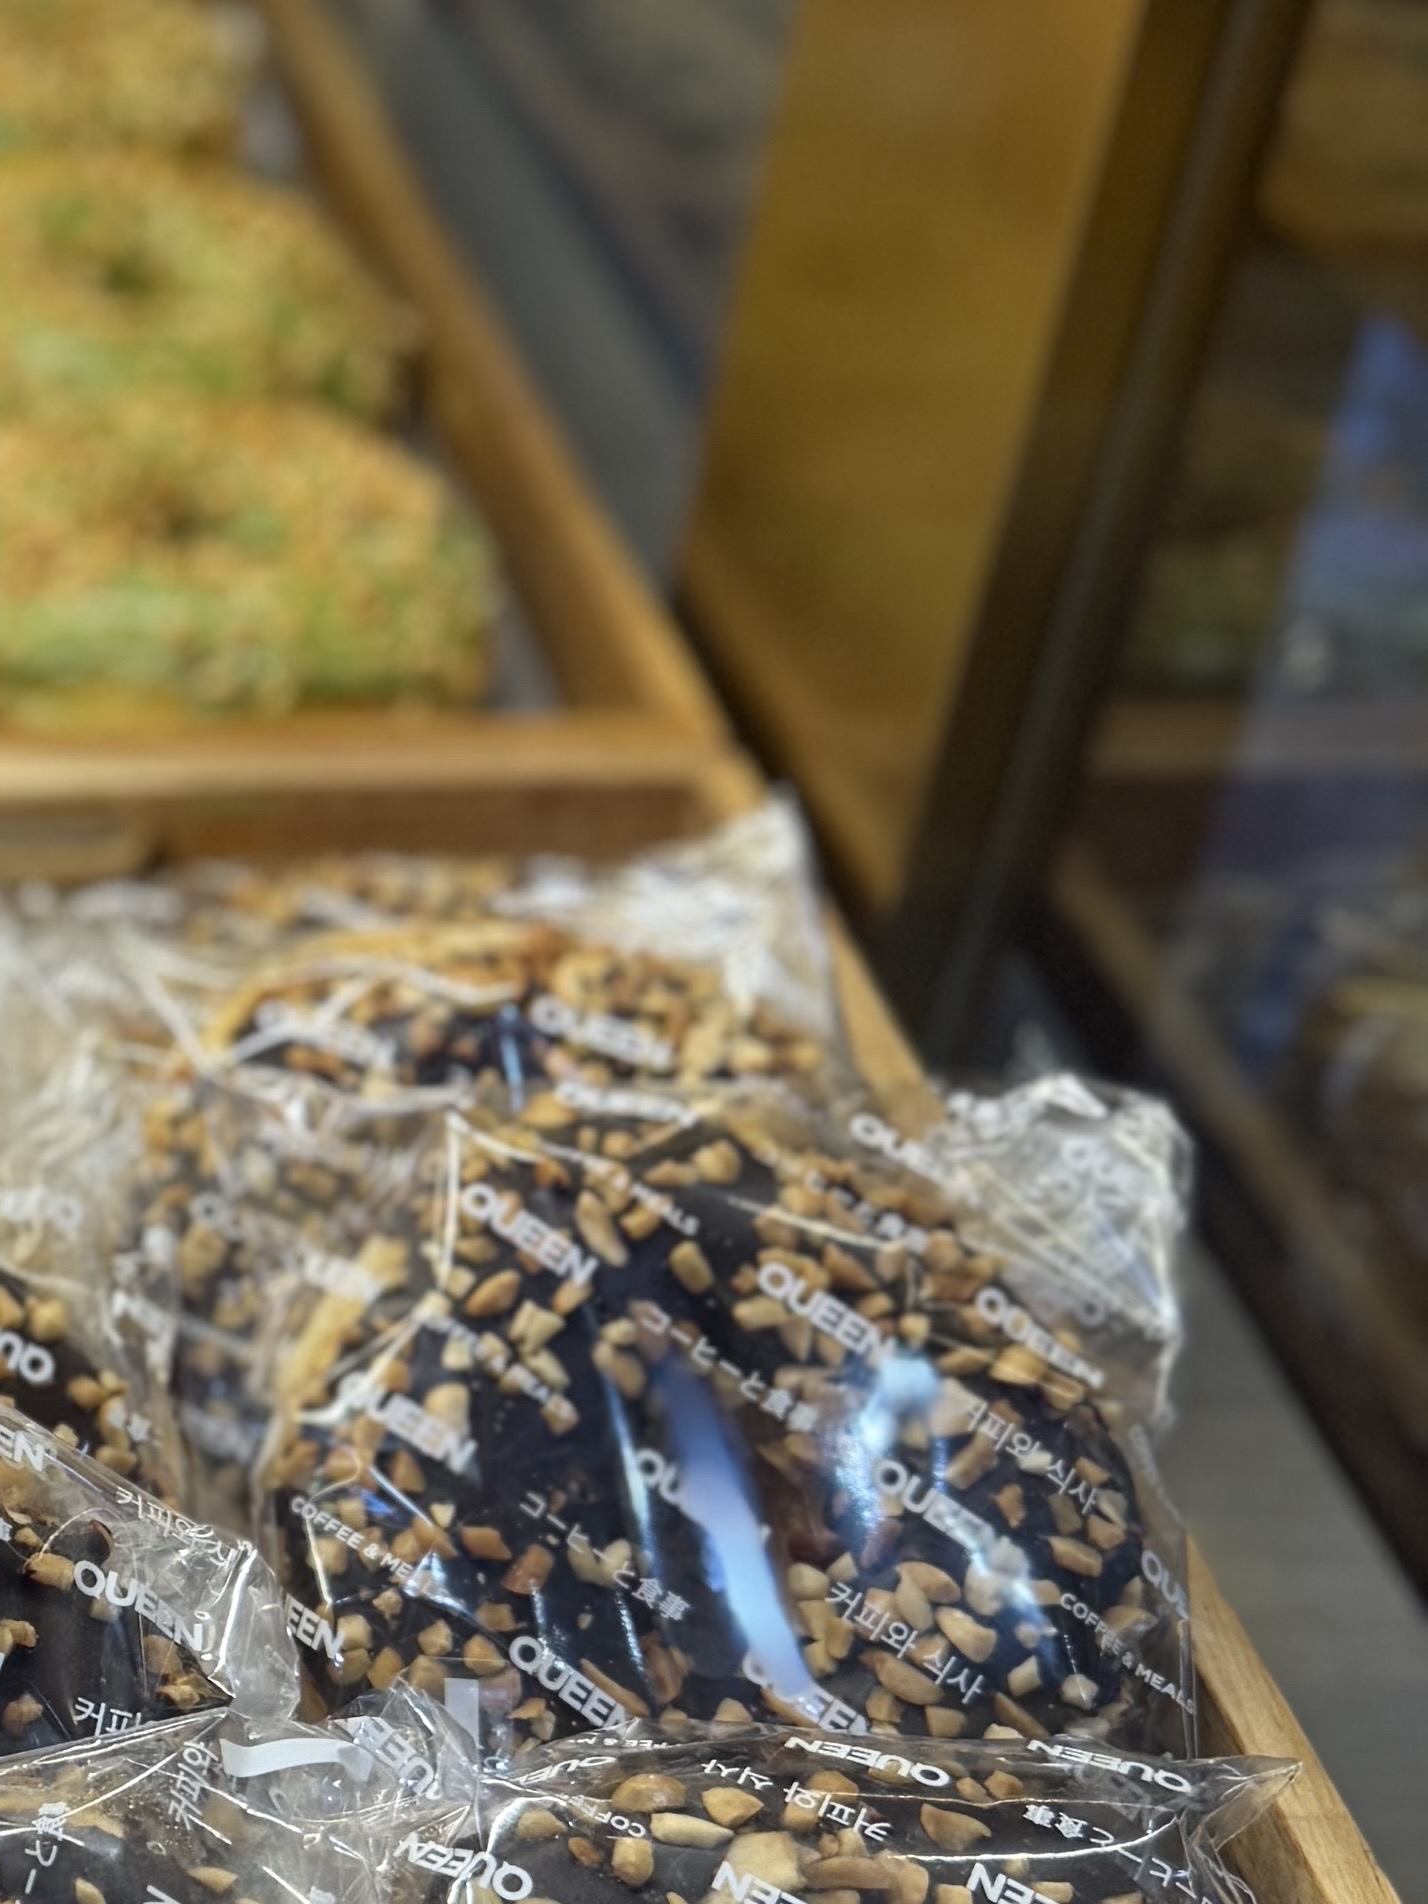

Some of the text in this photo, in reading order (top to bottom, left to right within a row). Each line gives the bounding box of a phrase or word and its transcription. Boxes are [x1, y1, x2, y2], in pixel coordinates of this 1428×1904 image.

[462, 1183, 599, 1287] QUEEN
[757, 1262, 899, 1363] QUEEN
[290, 1497, 364, 1548] COFFEE
[1046, 1455, 1099, 1515] 식사
[520, 1492, 691, 1621] コーヒーと食事
[73, 1560, 203, 1652] QUEEN
[824, 1581, 920, 1658] 커피와
[923, 1647, 986, 1704] 식사
[509, 1636, 640, 1728] QUEEN
[1135, 1665, 1195, 1713] MEALS
[703, 1759, 893, 1842] 커피와 식사
[783, 1735, 952, 1788] QUEEN
[1026, 1739, 1192, 1793] QUEEN
[395, 1832, 533, 1901] QUEEN
